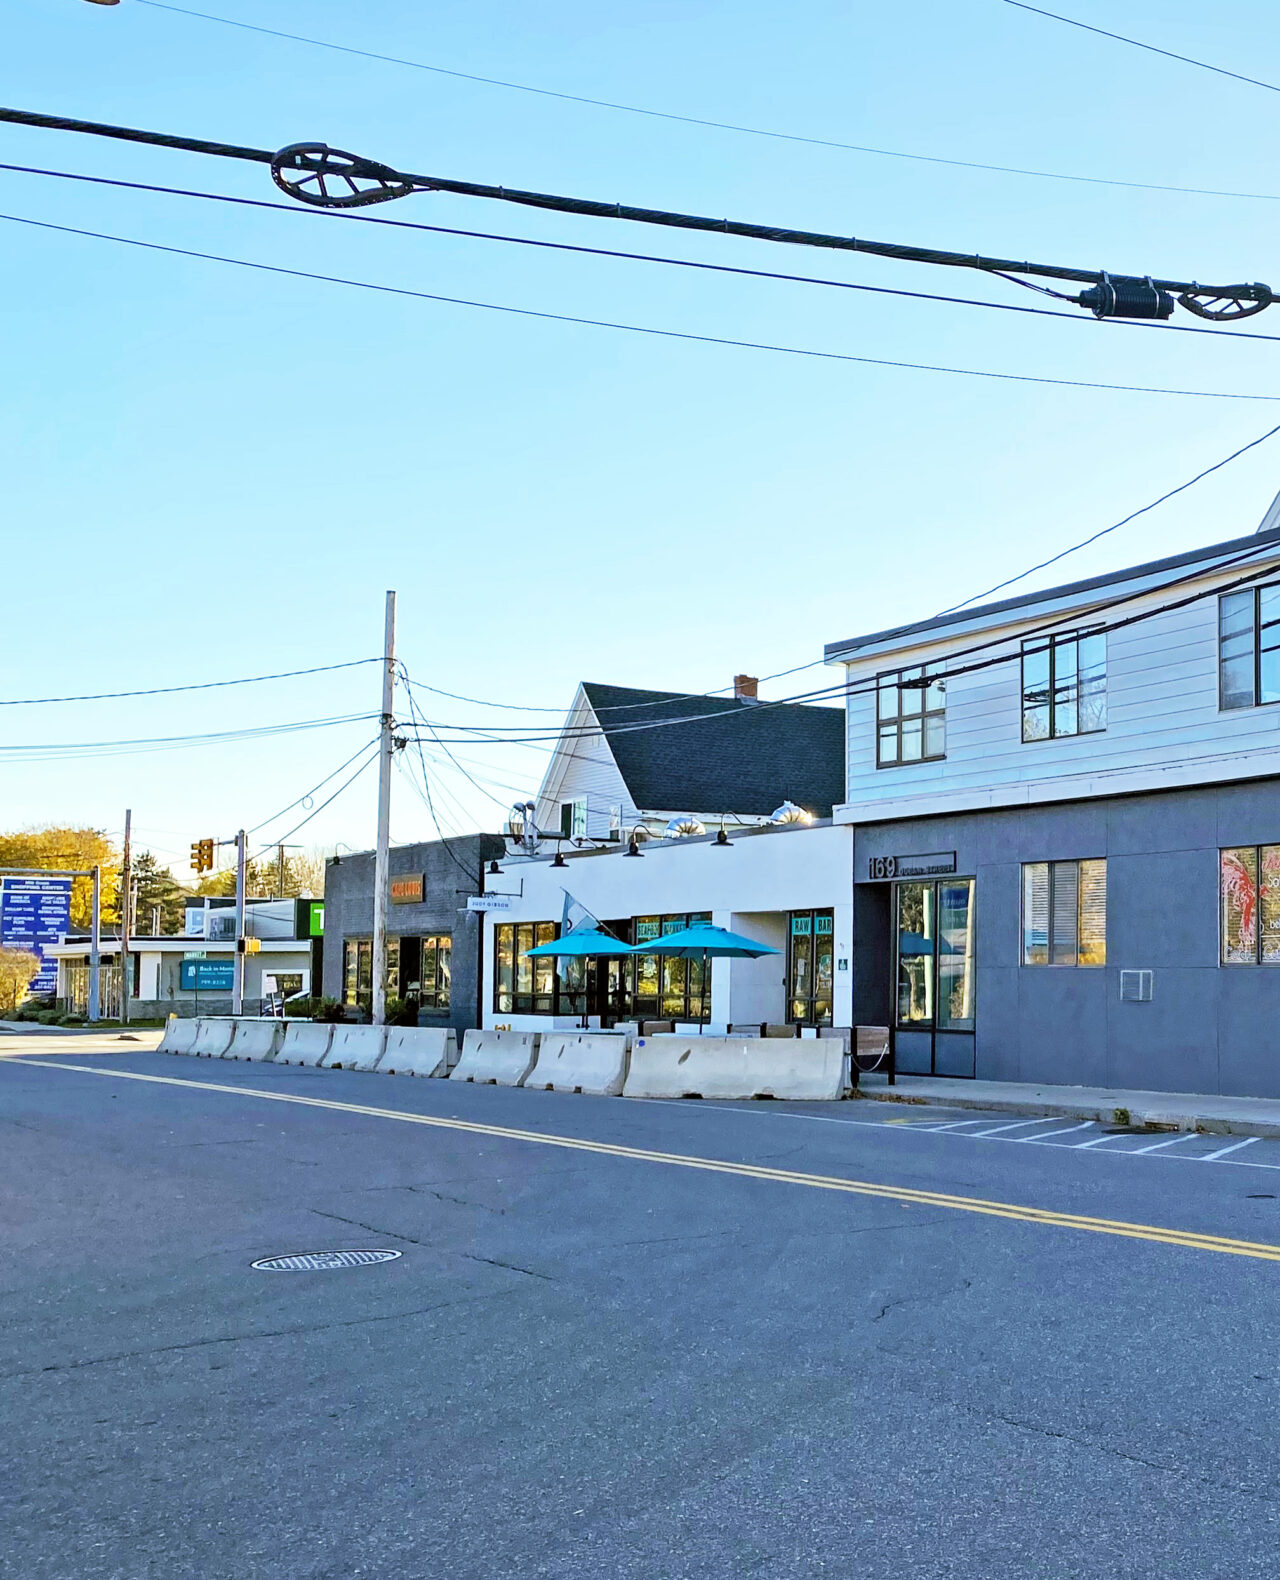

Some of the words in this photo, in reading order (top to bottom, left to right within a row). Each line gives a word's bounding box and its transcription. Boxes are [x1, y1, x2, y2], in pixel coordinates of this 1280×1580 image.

[869, 855, 896, 879] 169
[794, 919, 810, 933] RAW
[818, 918, 832, 932] BAR
